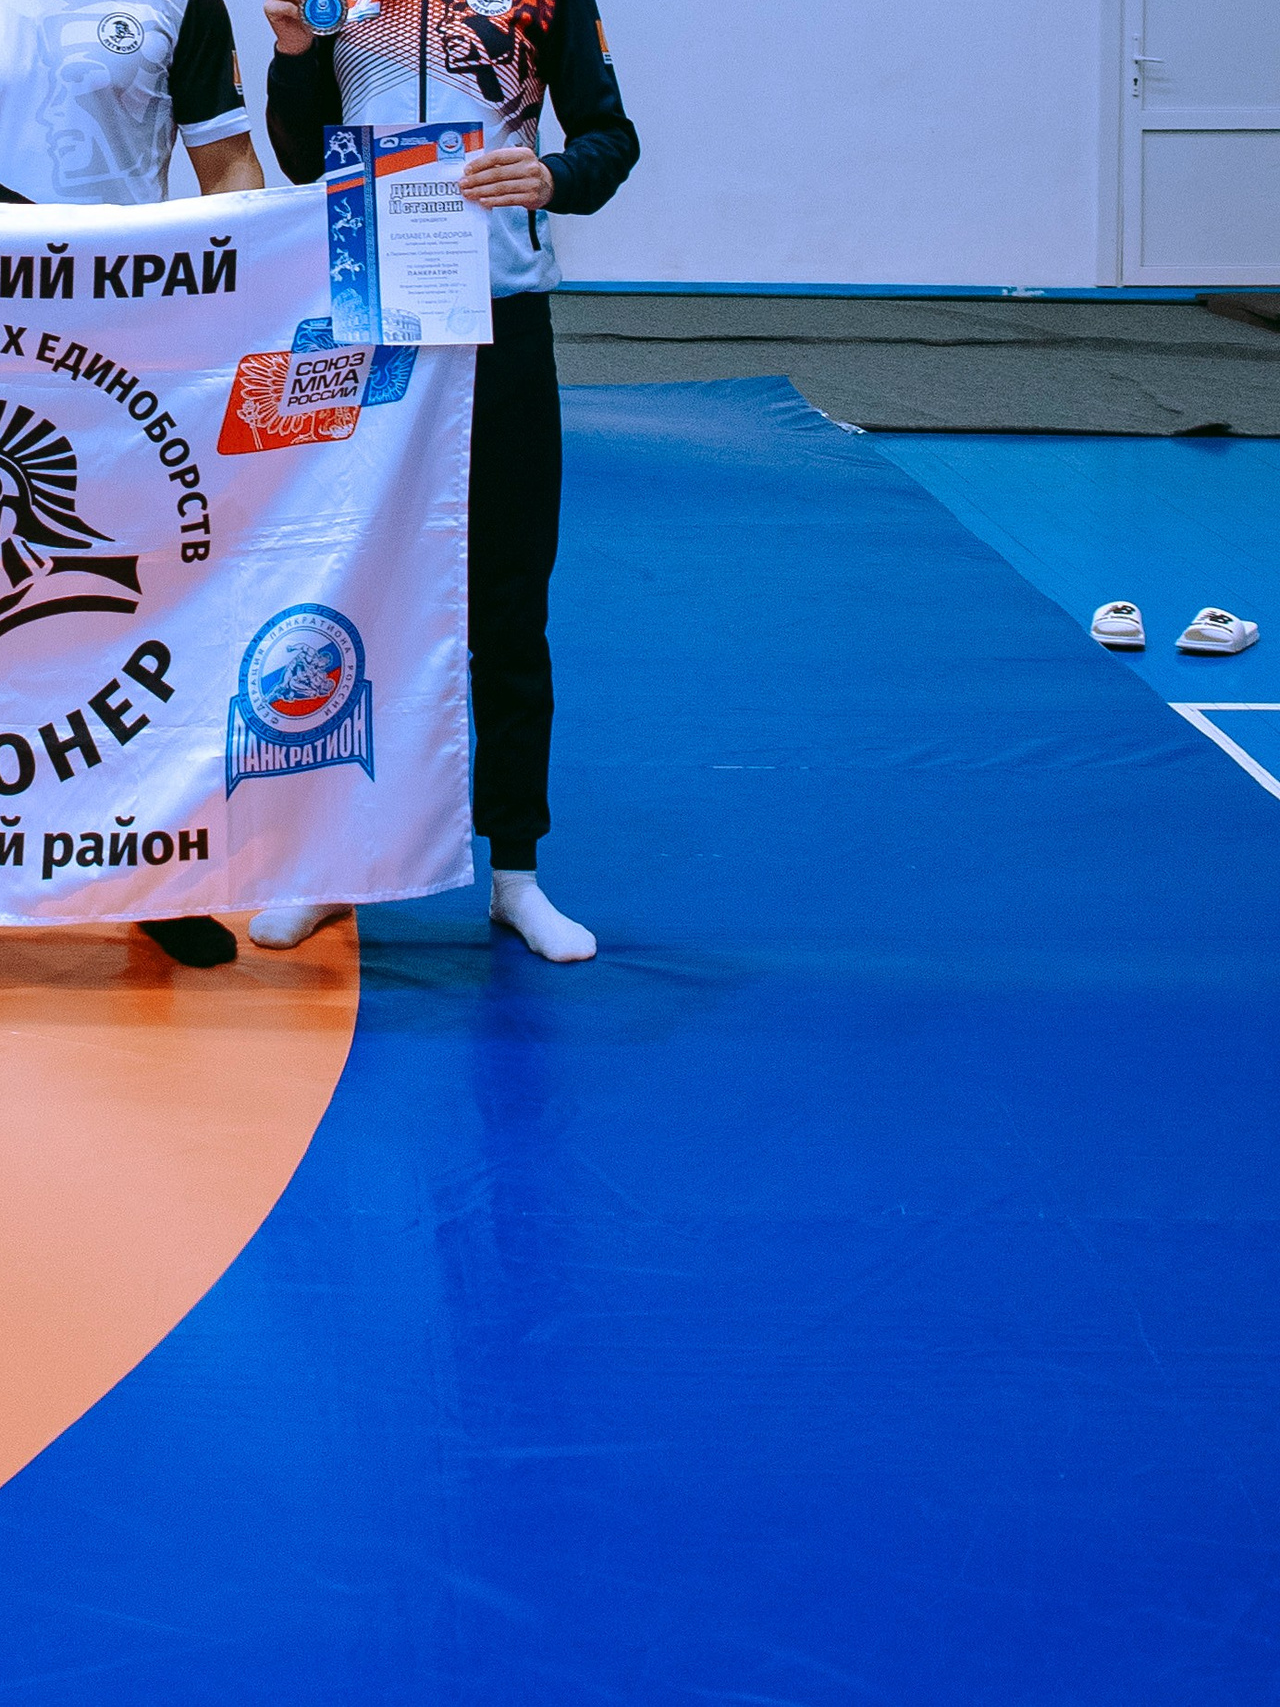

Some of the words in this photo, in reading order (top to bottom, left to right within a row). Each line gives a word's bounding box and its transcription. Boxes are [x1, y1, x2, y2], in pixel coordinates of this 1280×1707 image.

[390, 181, 460, 199] ДИПЛОМ
[402, 201, 463, 214] степени
[93, 236, 237, 298] КРАЙ
[291, 369, 359, 394] ММА
[296, 352, 365, 377] СОЮЗ
[287, 385, 358, 408] РОССИИ
[36, 332, 211, 564] ЕДИНОБОРСТВ
[252, 649, 279, 725] ФЕДЕРАЦИЯ
[270, 616, 351, 654] ПАНКРАТИОНА
[324, 665, 354, 717] РОССИИ
[231, 688, 367, 780] ПАНКРАТИОН
[42, 815, 209, 880] район
